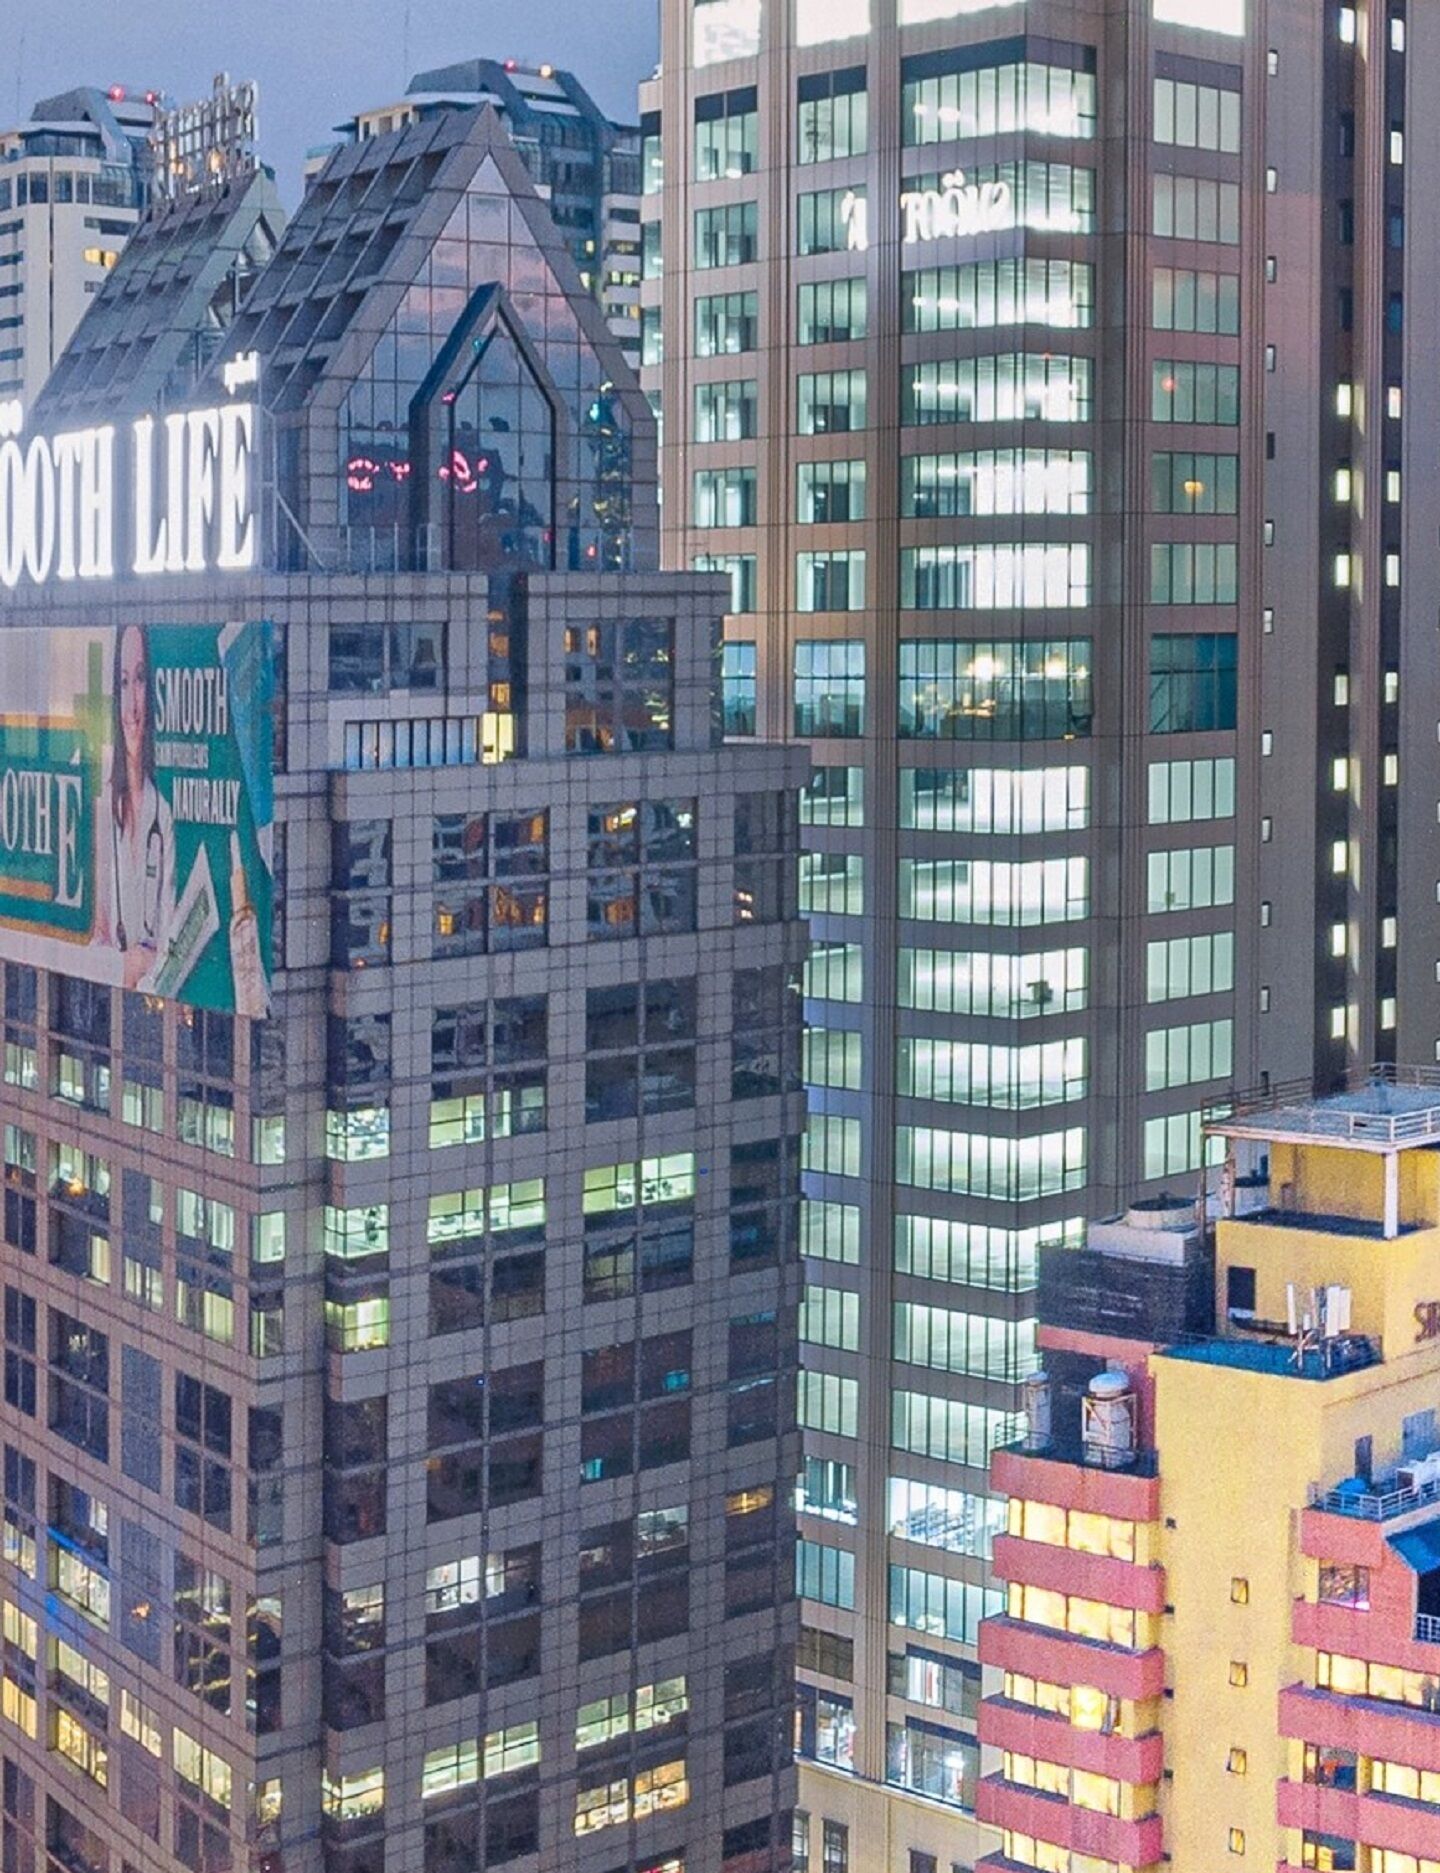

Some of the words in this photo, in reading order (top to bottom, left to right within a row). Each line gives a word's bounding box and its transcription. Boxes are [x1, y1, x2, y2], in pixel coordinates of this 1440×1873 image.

[132, 402, 254, 573] LIFE
[155, 667, 227, 736] SMOOTH
[173, 776, 241, 825] NATURALLY
